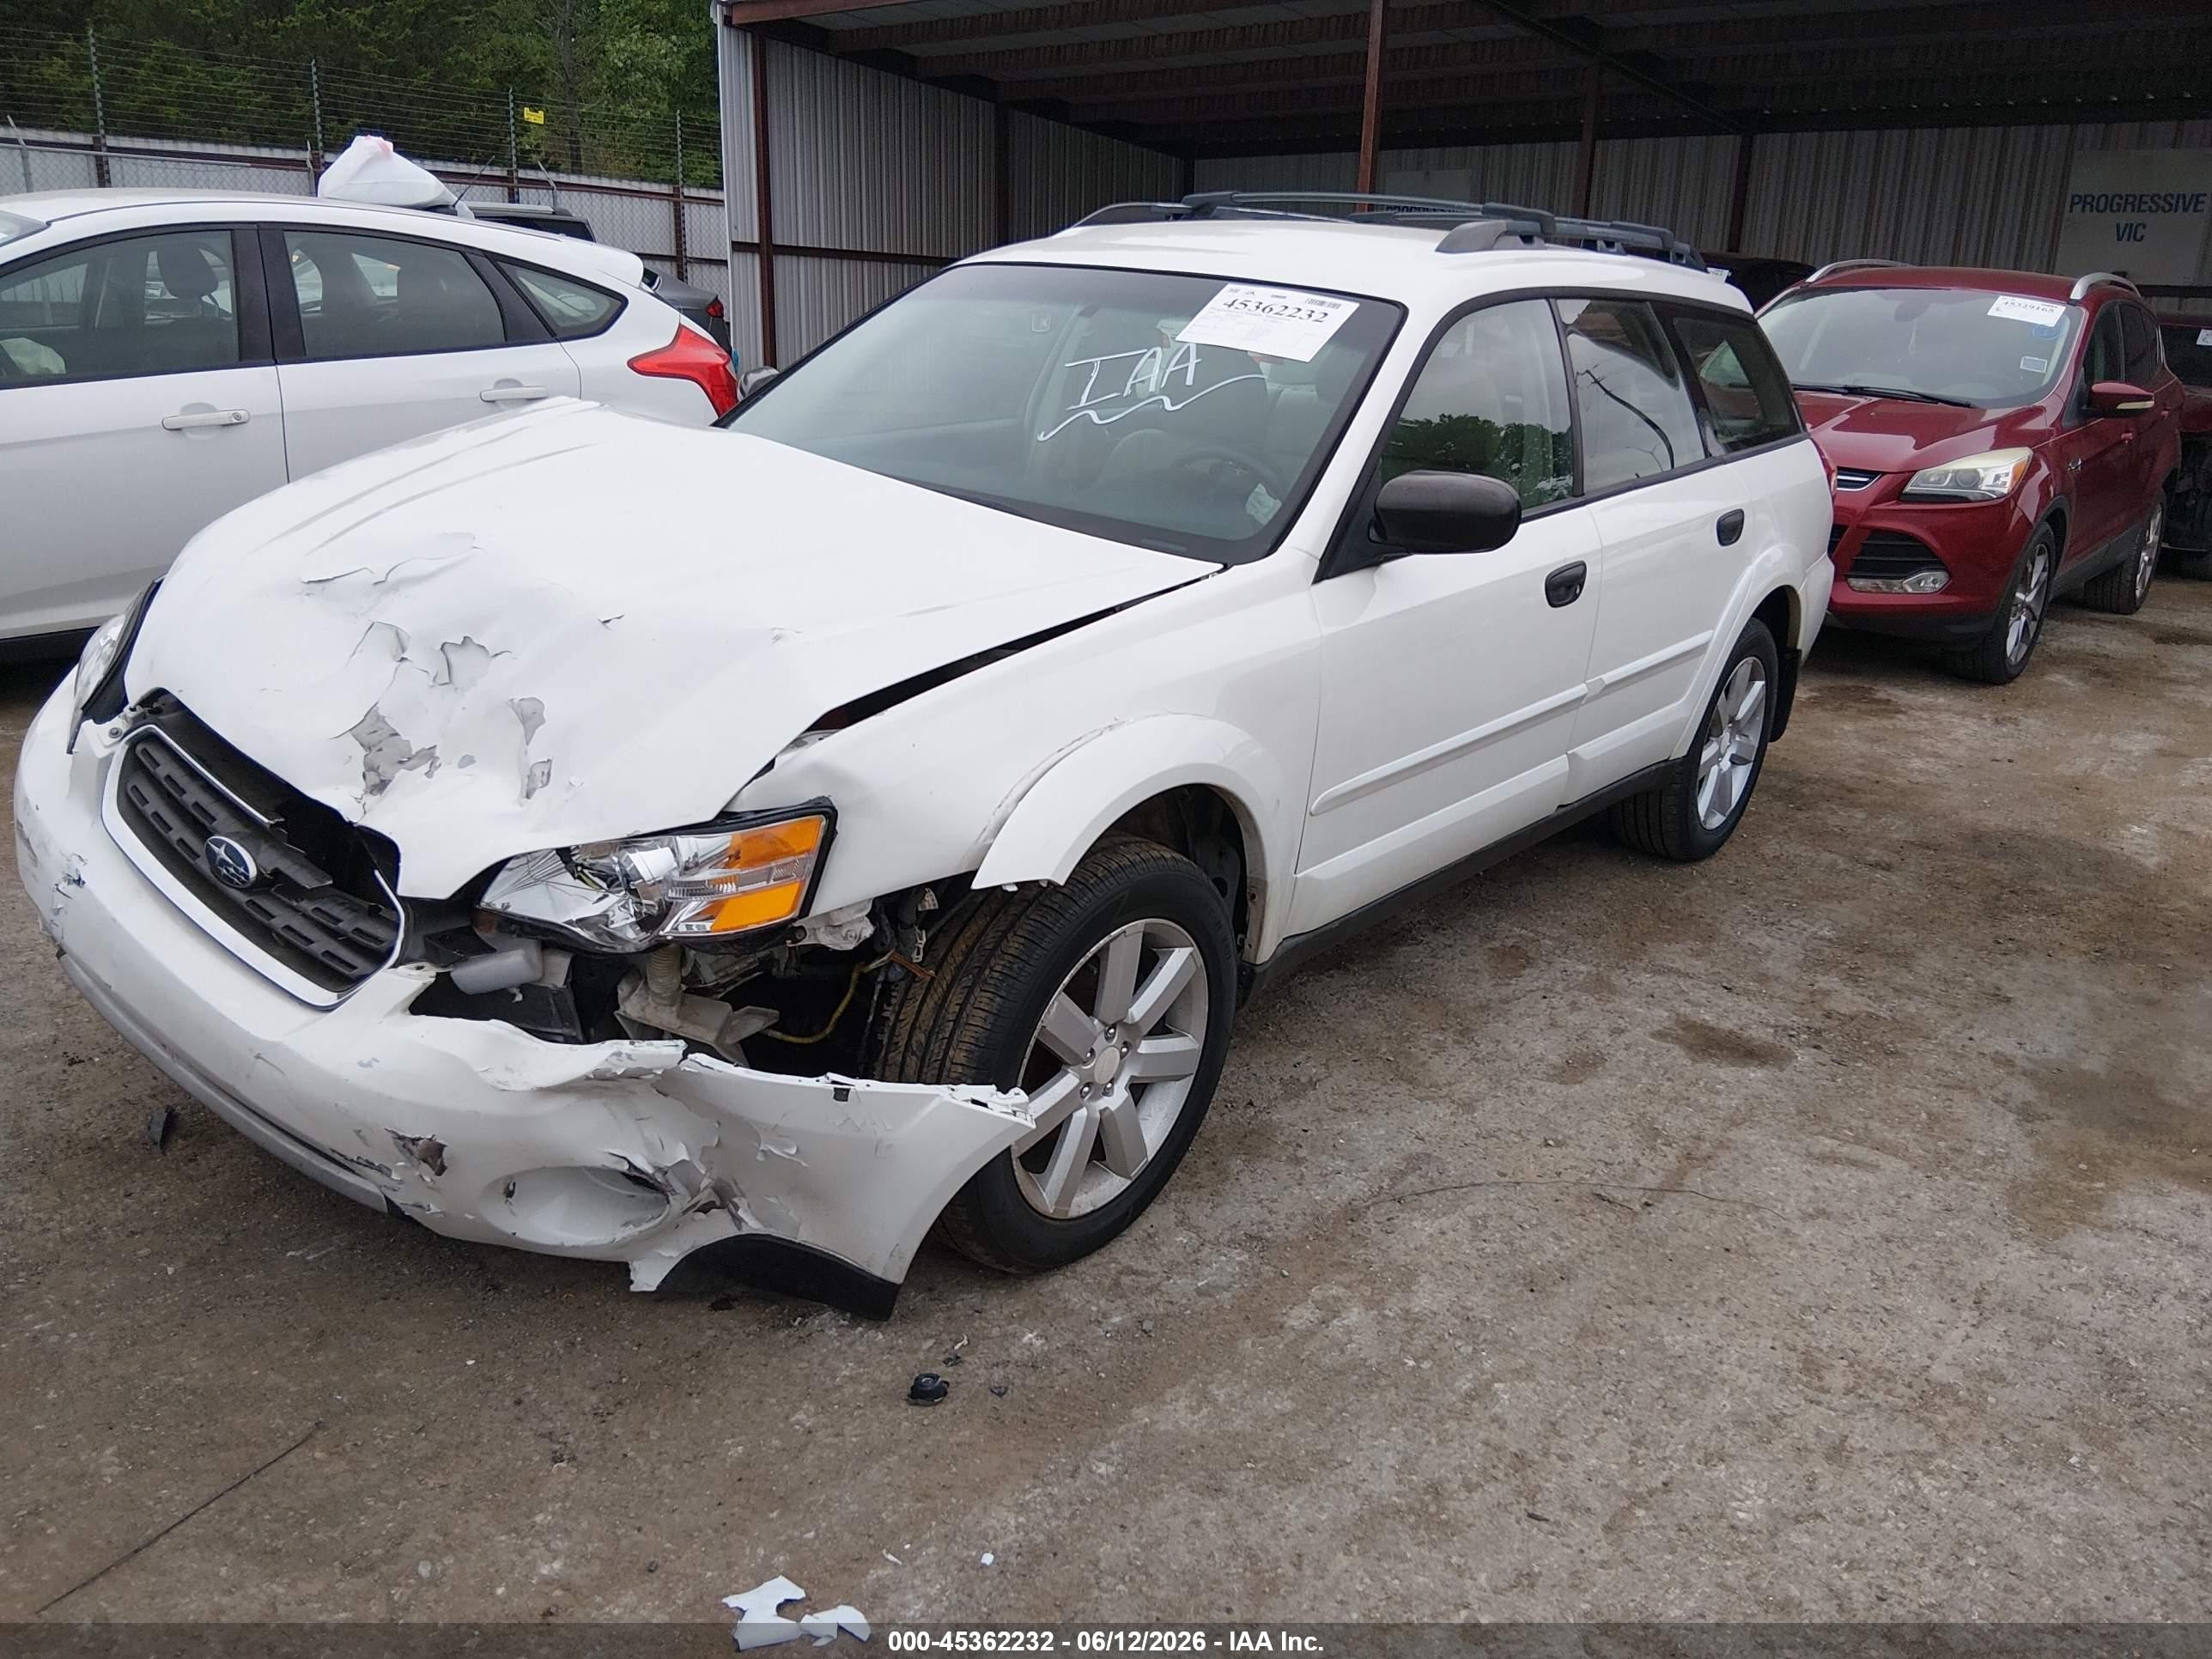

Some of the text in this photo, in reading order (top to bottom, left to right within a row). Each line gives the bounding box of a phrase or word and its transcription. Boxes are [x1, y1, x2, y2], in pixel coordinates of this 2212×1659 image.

[2069, 192, 2208, 214] PROGRESSIVE
[2115, 222, 2147, 242] VIC
[1222, 297, 1329, 324] 45362232
[1064, 342, 1202, 411] IAA
